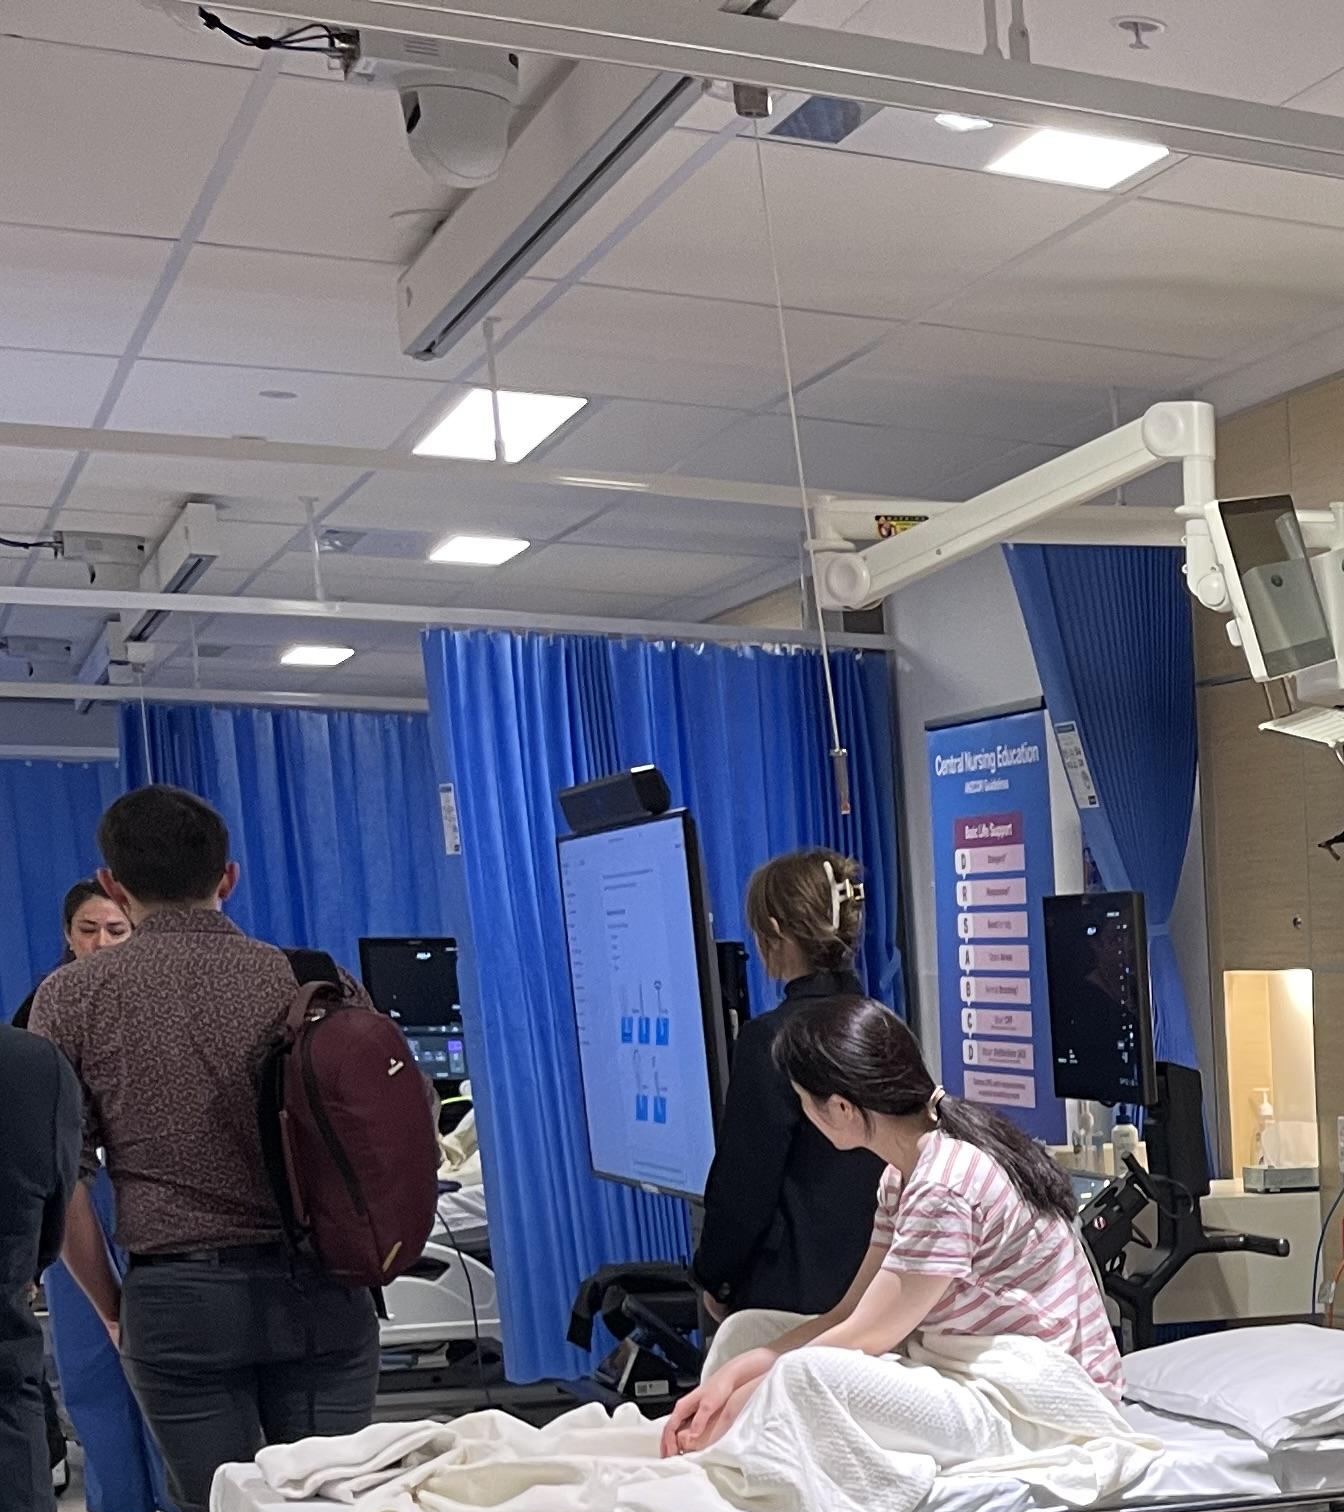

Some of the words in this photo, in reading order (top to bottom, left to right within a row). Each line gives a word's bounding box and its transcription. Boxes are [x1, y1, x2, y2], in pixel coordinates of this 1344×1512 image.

[935, 752, 964, 776] Central
[964, 748, 996, 774] Nursing
[997, 742, 1040, 768] Education
[990, 822, 1013, 840] Support
[961, 853, 967, 870] D
[962, 885, 968, 902] R
[963, 917, 969, 934] S
[964, 949, 970, 965] A
[966, 1012, 972, 1029] C
[968, 1044, 974, 1061] D
